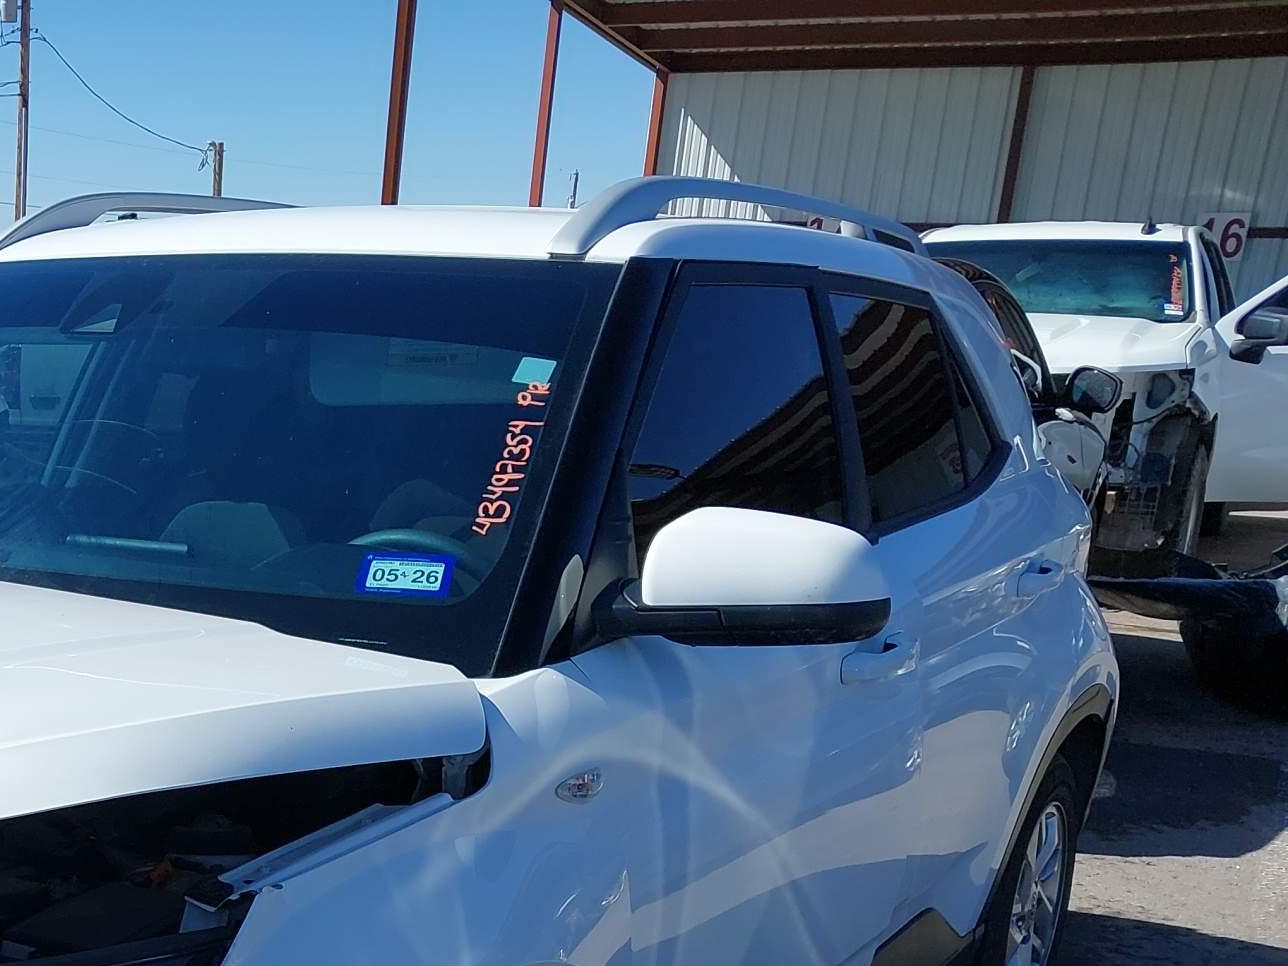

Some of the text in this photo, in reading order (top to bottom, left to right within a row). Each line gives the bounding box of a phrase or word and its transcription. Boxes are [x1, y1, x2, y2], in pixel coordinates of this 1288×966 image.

[471, 420, 545, 536] 43497354
[372, 568, 440, 584] 05 26
